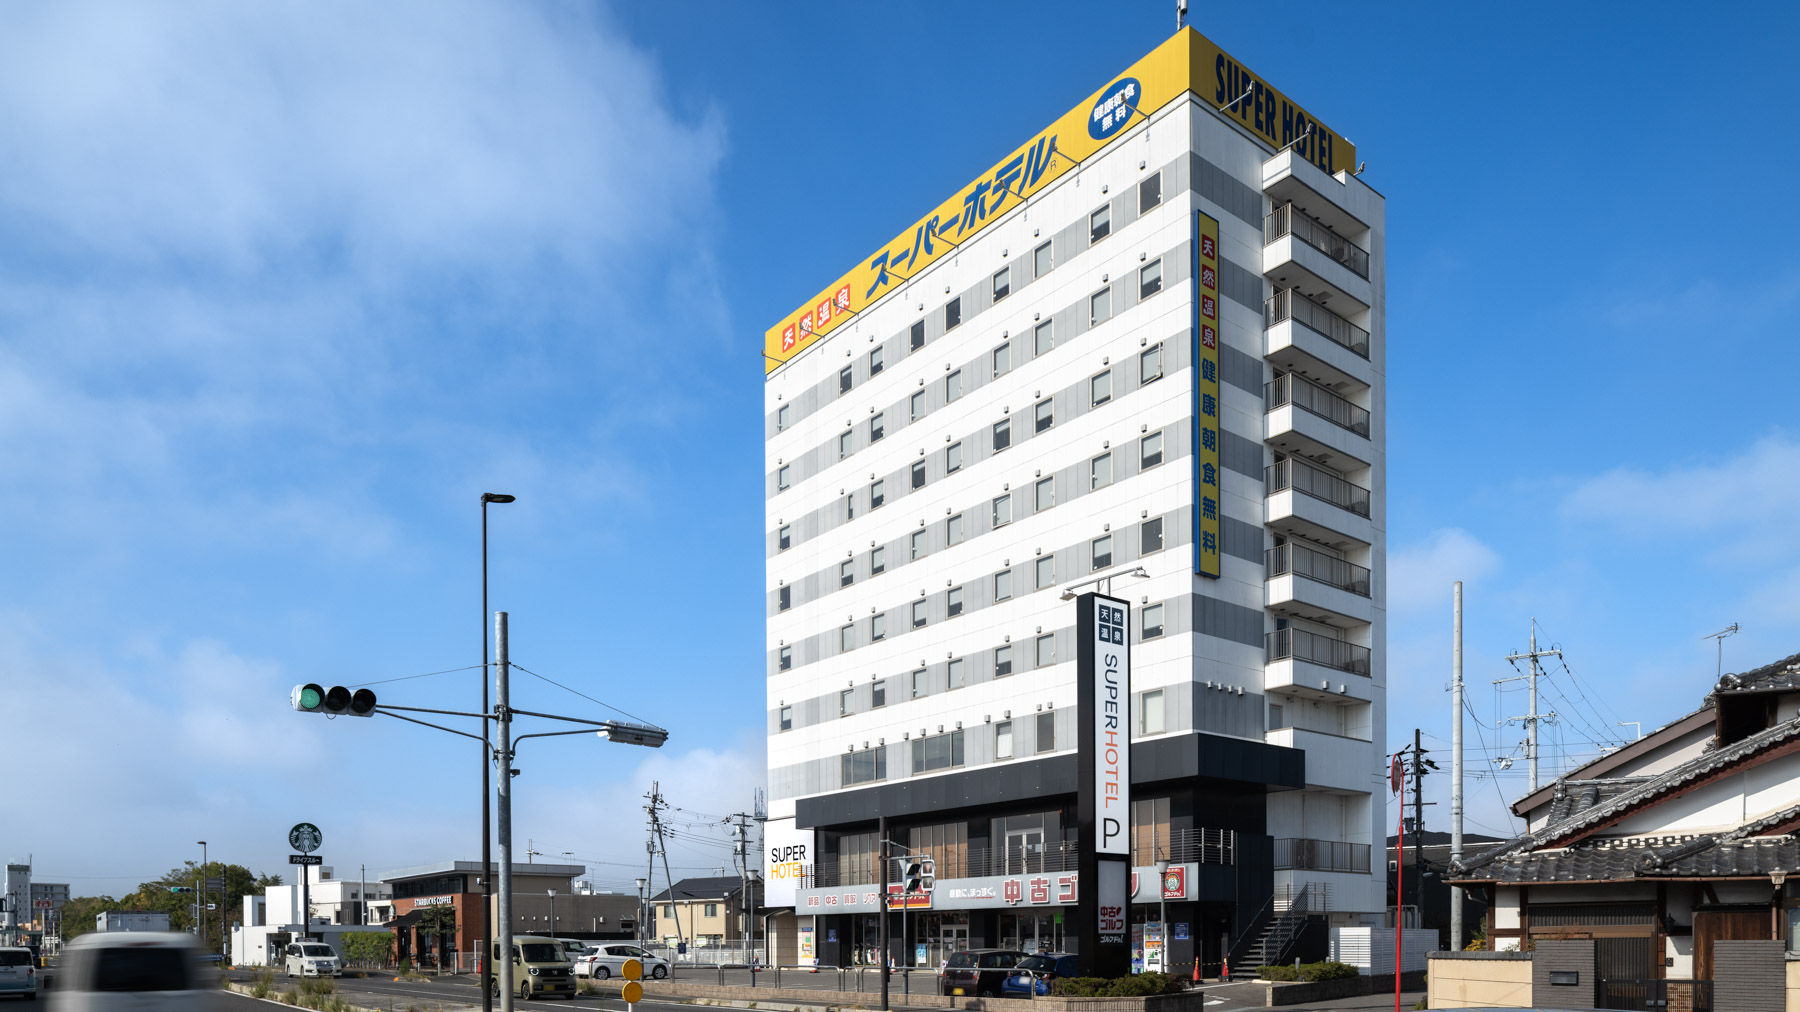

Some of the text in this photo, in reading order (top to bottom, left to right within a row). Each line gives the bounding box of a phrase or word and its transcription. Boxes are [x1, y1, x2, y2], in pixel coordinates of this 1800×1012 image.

[1102, 103, 1126, 132] 無料
[1216, 53, 1335, 176] SUPER HOTEL
[866, 134, 1058, 300] スーパーホテル
[783, 287, 850, 351] 天然温泉
[1103, 817, 1121, 849] P
[771, 844, 806, 863] SUPER
[771, 862, 806, 880] HOTEL
[437, 895, 453, 904] COFFEE
[825, 895, 838, 906] 中古
[1100, 905, 1116, 918] 中古
[1100, 918, 1124, 931] ゴルフ
